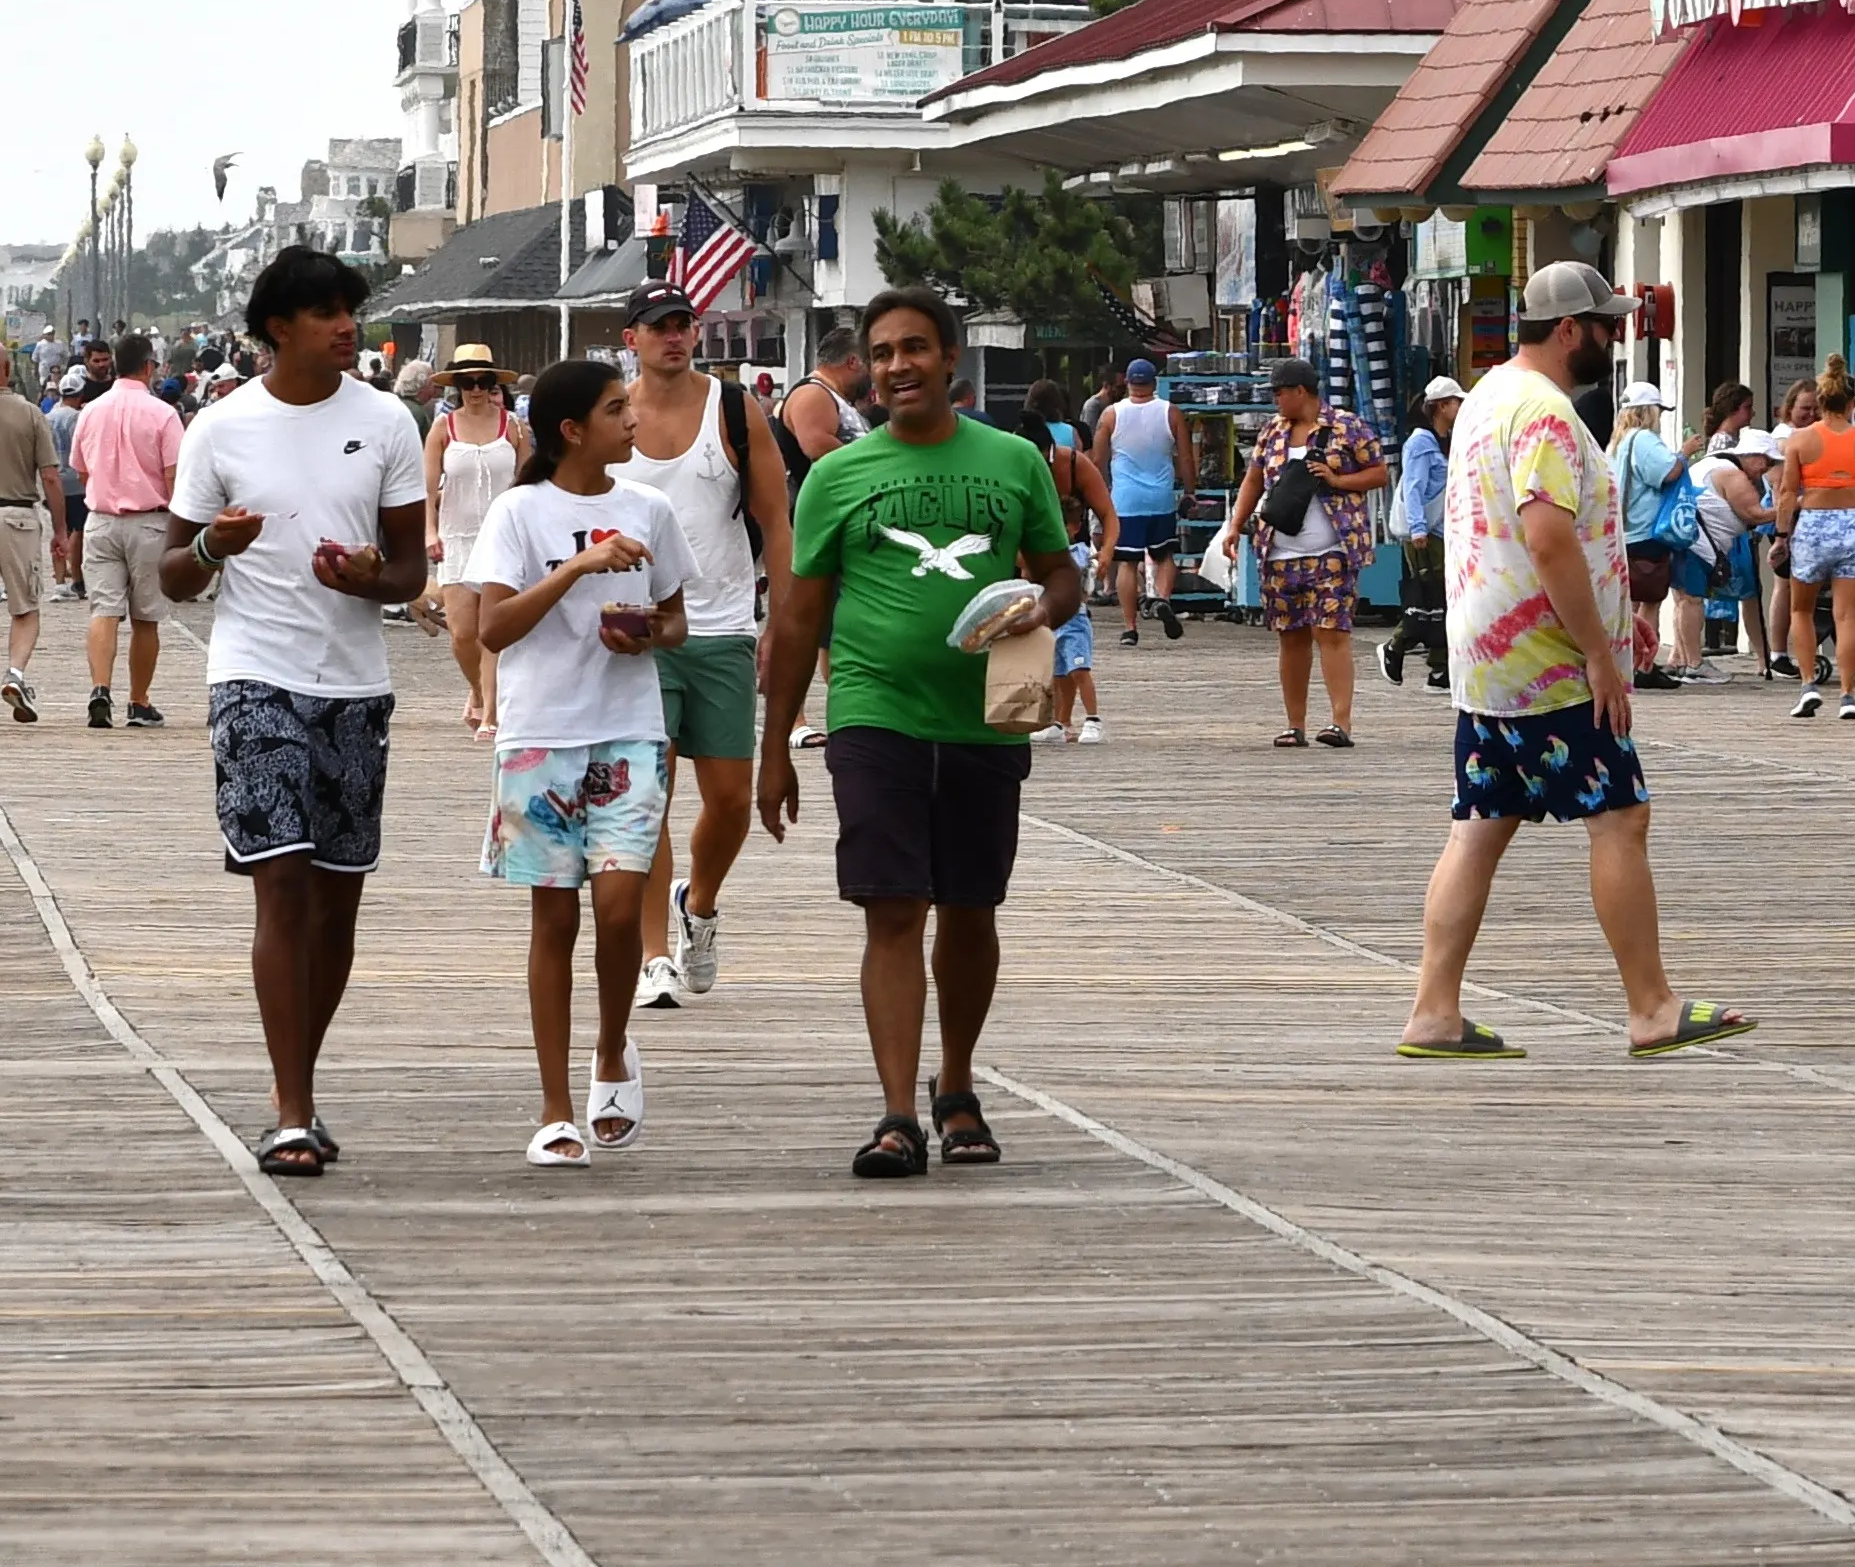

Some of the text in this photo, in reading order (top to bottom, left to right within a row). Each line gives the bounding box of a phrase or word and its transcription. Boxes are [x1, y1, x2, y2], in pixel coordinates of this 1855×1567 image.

[804, 13, 847, 32] HAPPY
[850, 11, 886, 29] HOUR
[869, 474, 1001, 494] PHILADELPHIA
[866, 484, 1011, 555] EAGLES
[571, 530, 589, 555] I
